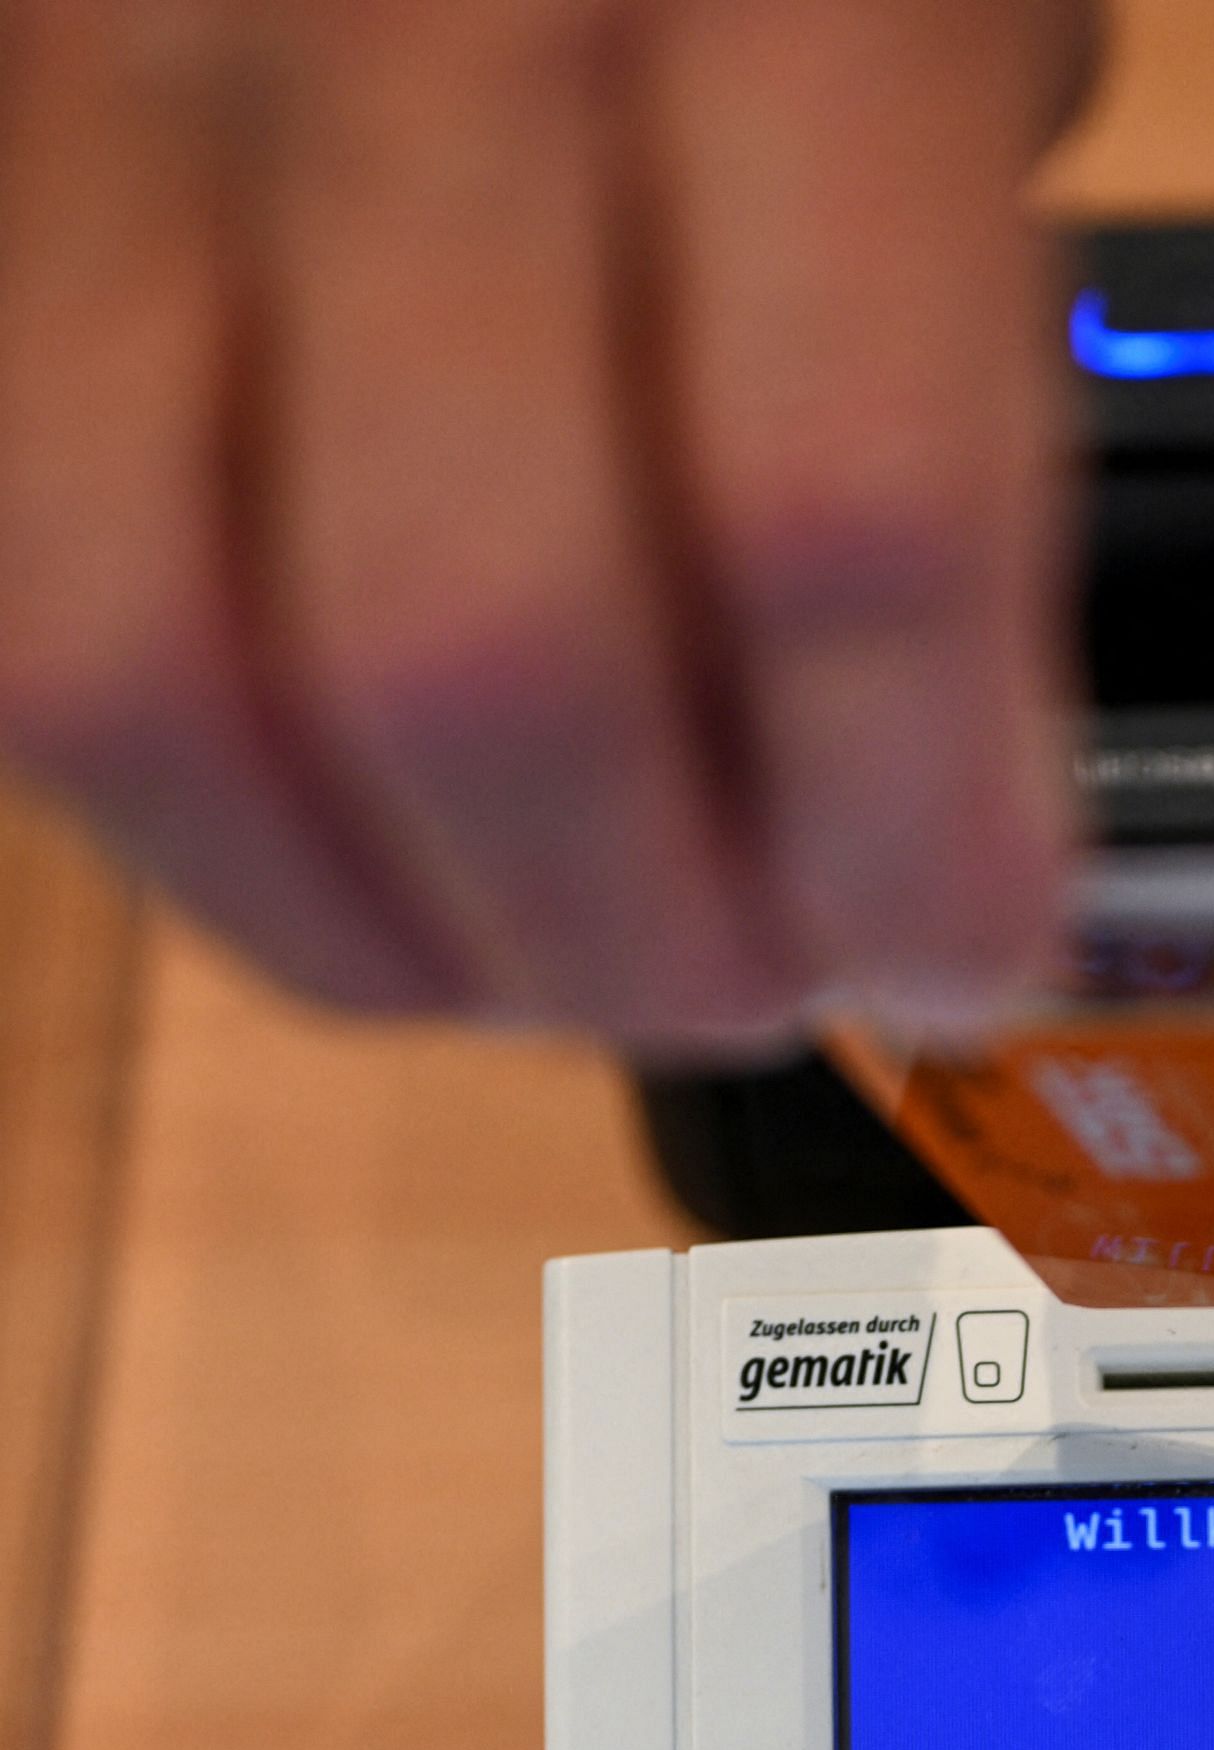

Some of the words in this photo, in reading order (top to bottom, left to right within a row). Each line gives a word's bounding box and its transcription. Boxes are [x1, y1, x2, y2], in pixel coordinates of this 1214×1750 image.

[749, 1318, 860, 1341] Zugelassen
[865, 1314, 920, 1334] durch
[739, 1340, 912, 1402] gematik
